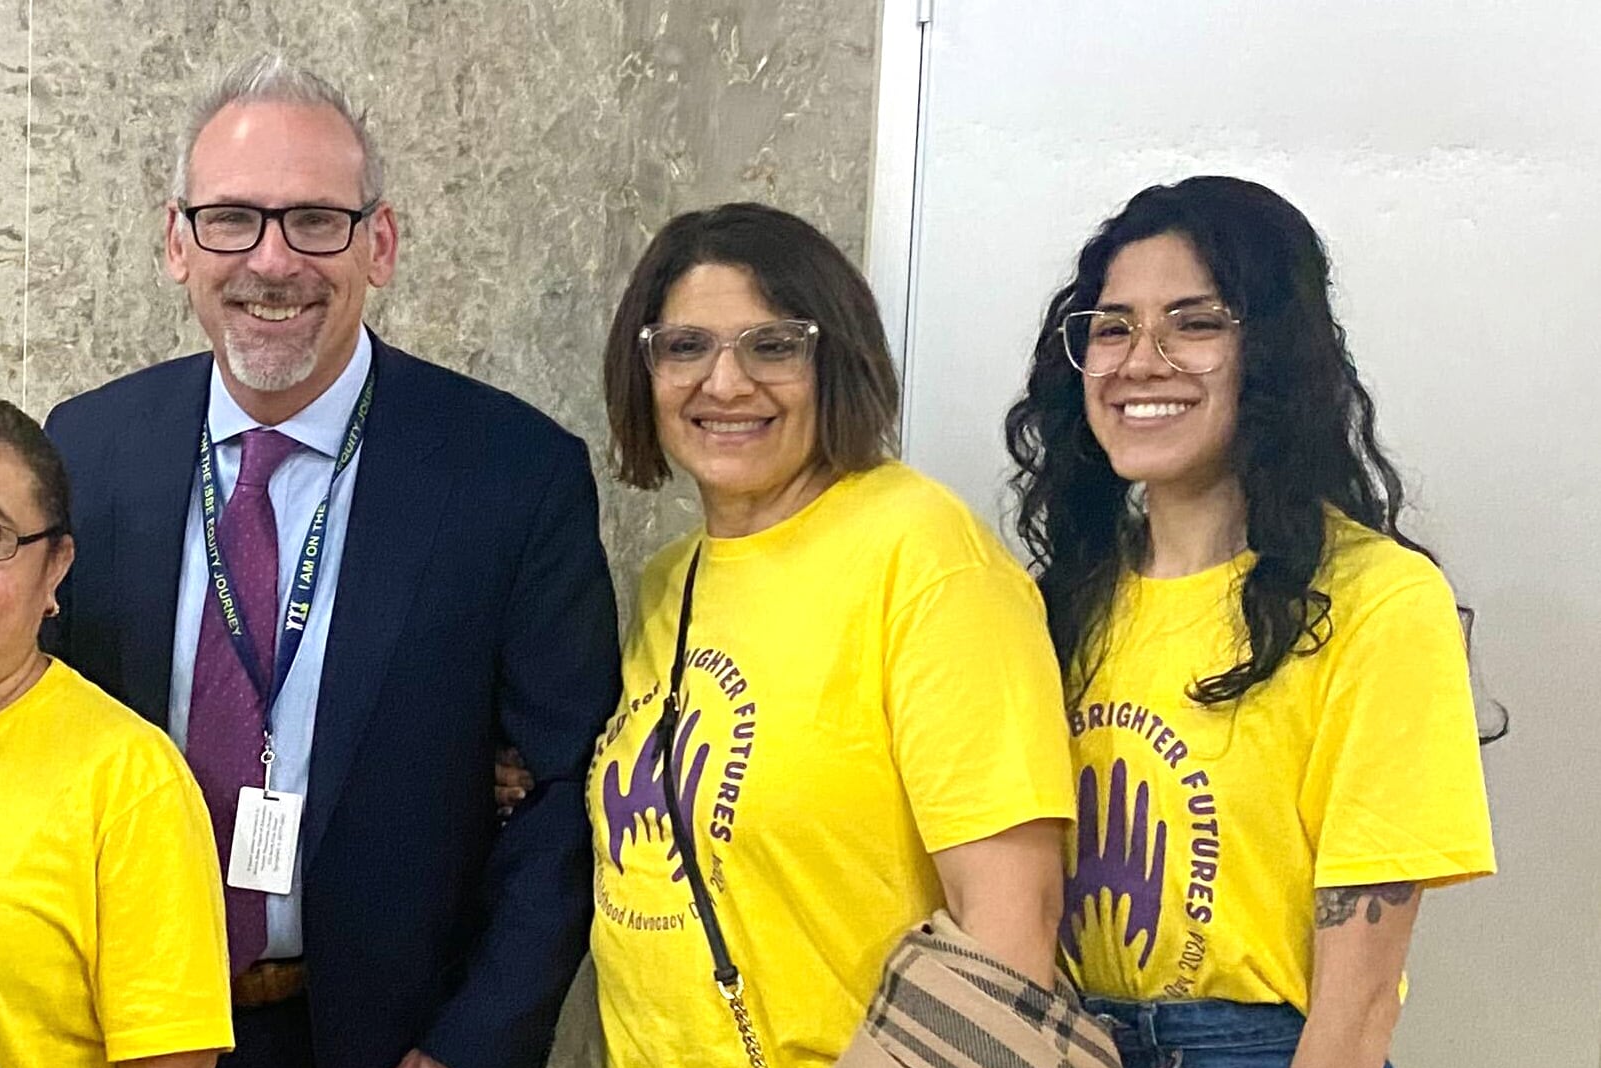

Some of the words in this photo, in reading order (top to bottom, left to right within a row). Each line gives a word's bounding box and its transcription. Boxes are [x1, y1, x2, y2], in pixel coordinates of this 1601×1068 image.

[201, 454, 213, 482] THE
[312, 504, 327, 531] THE
[206, 517, 222, 566] EQUITY
[306, 535, 320, 557] ON
[299, 560, 315, 583] AM
[213, 571, 242, 636] JOURNEY
[686, 648, 747, 701] IGHTER
[631, 680, 660, 712] for
[710, 702, 756, 844] FUTURES
[1070, 702, 1188, 769] BRIGHTER
[1181, 770, 1220, 925] FUTURES
[1178, 930, 1206, 971] 2024
